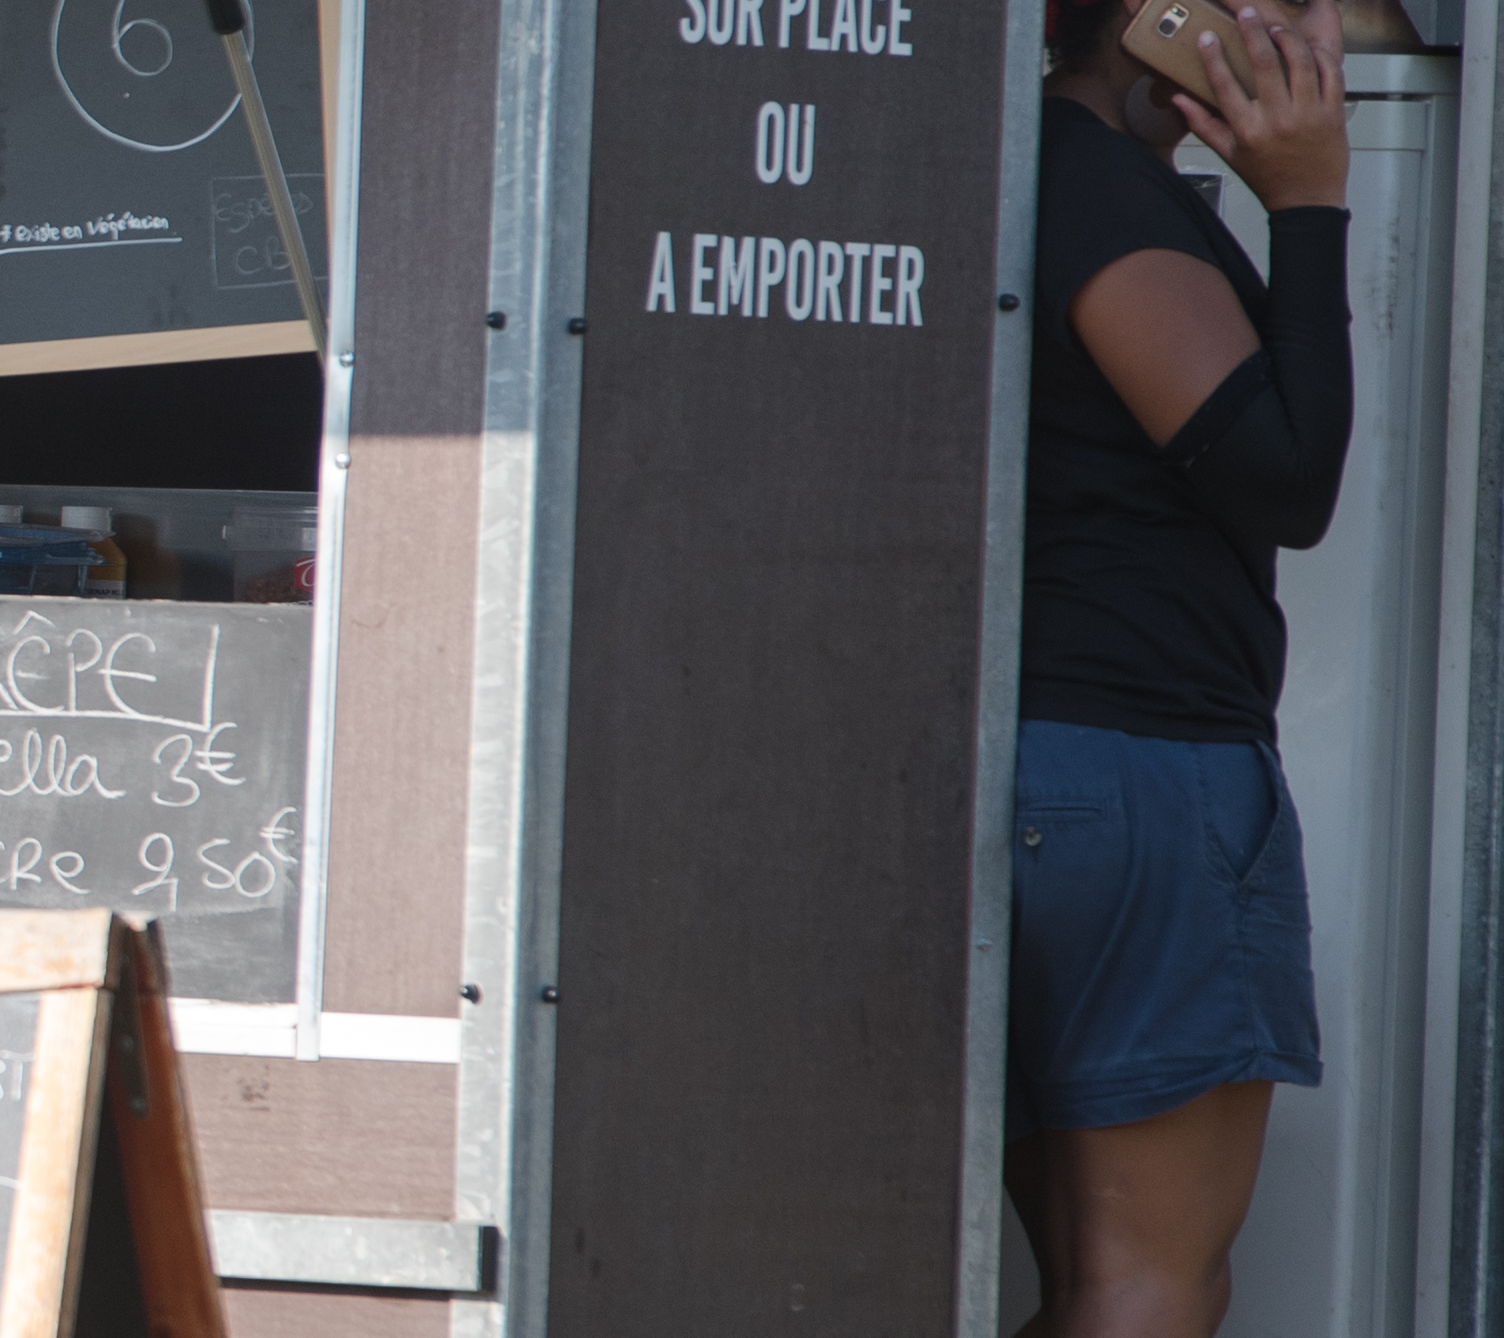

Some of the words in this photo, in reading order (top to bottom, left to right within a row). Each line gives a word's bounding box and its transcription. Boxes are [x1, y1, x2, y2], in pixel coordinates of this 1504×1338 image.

[755, 100, 816, 186] OU
[645, 231, 677, 313] A
[690, 233, 926, 328] EMPORTER
